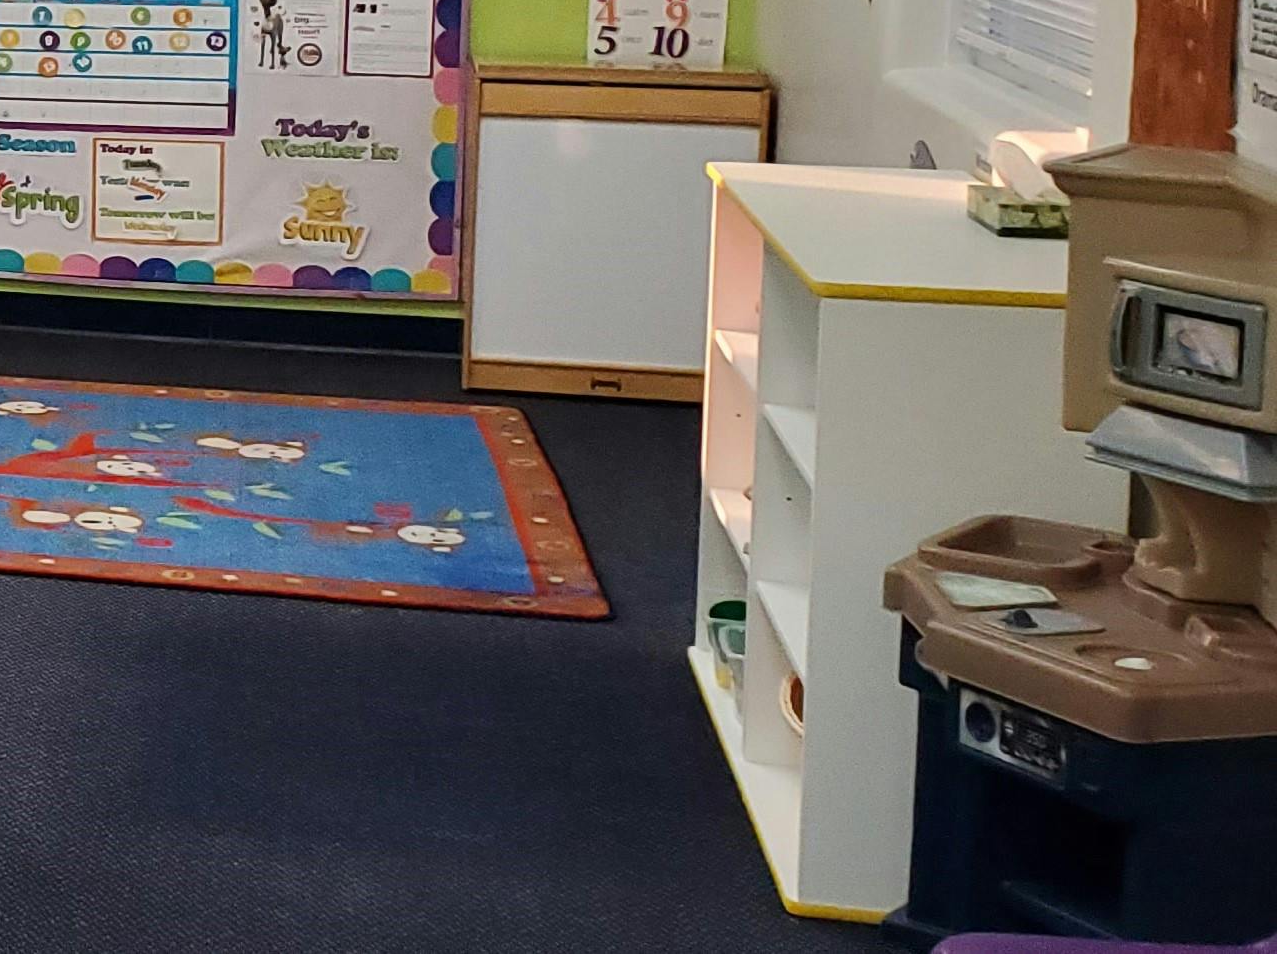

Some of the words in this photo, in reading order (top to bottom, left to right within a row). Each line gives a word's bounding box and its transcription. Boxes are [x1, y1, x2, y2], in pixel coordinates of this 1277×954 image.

[666, 2, 689, 28] 9
[594, 25, 620, 55] 5
[648, 26, 689, 58] 10
[275, 118, 370, 142] Today's
[100, 144, 136, 155] Today
[261, 139, 367, 160] Weather
[1, 184, 80, 223] Spring
